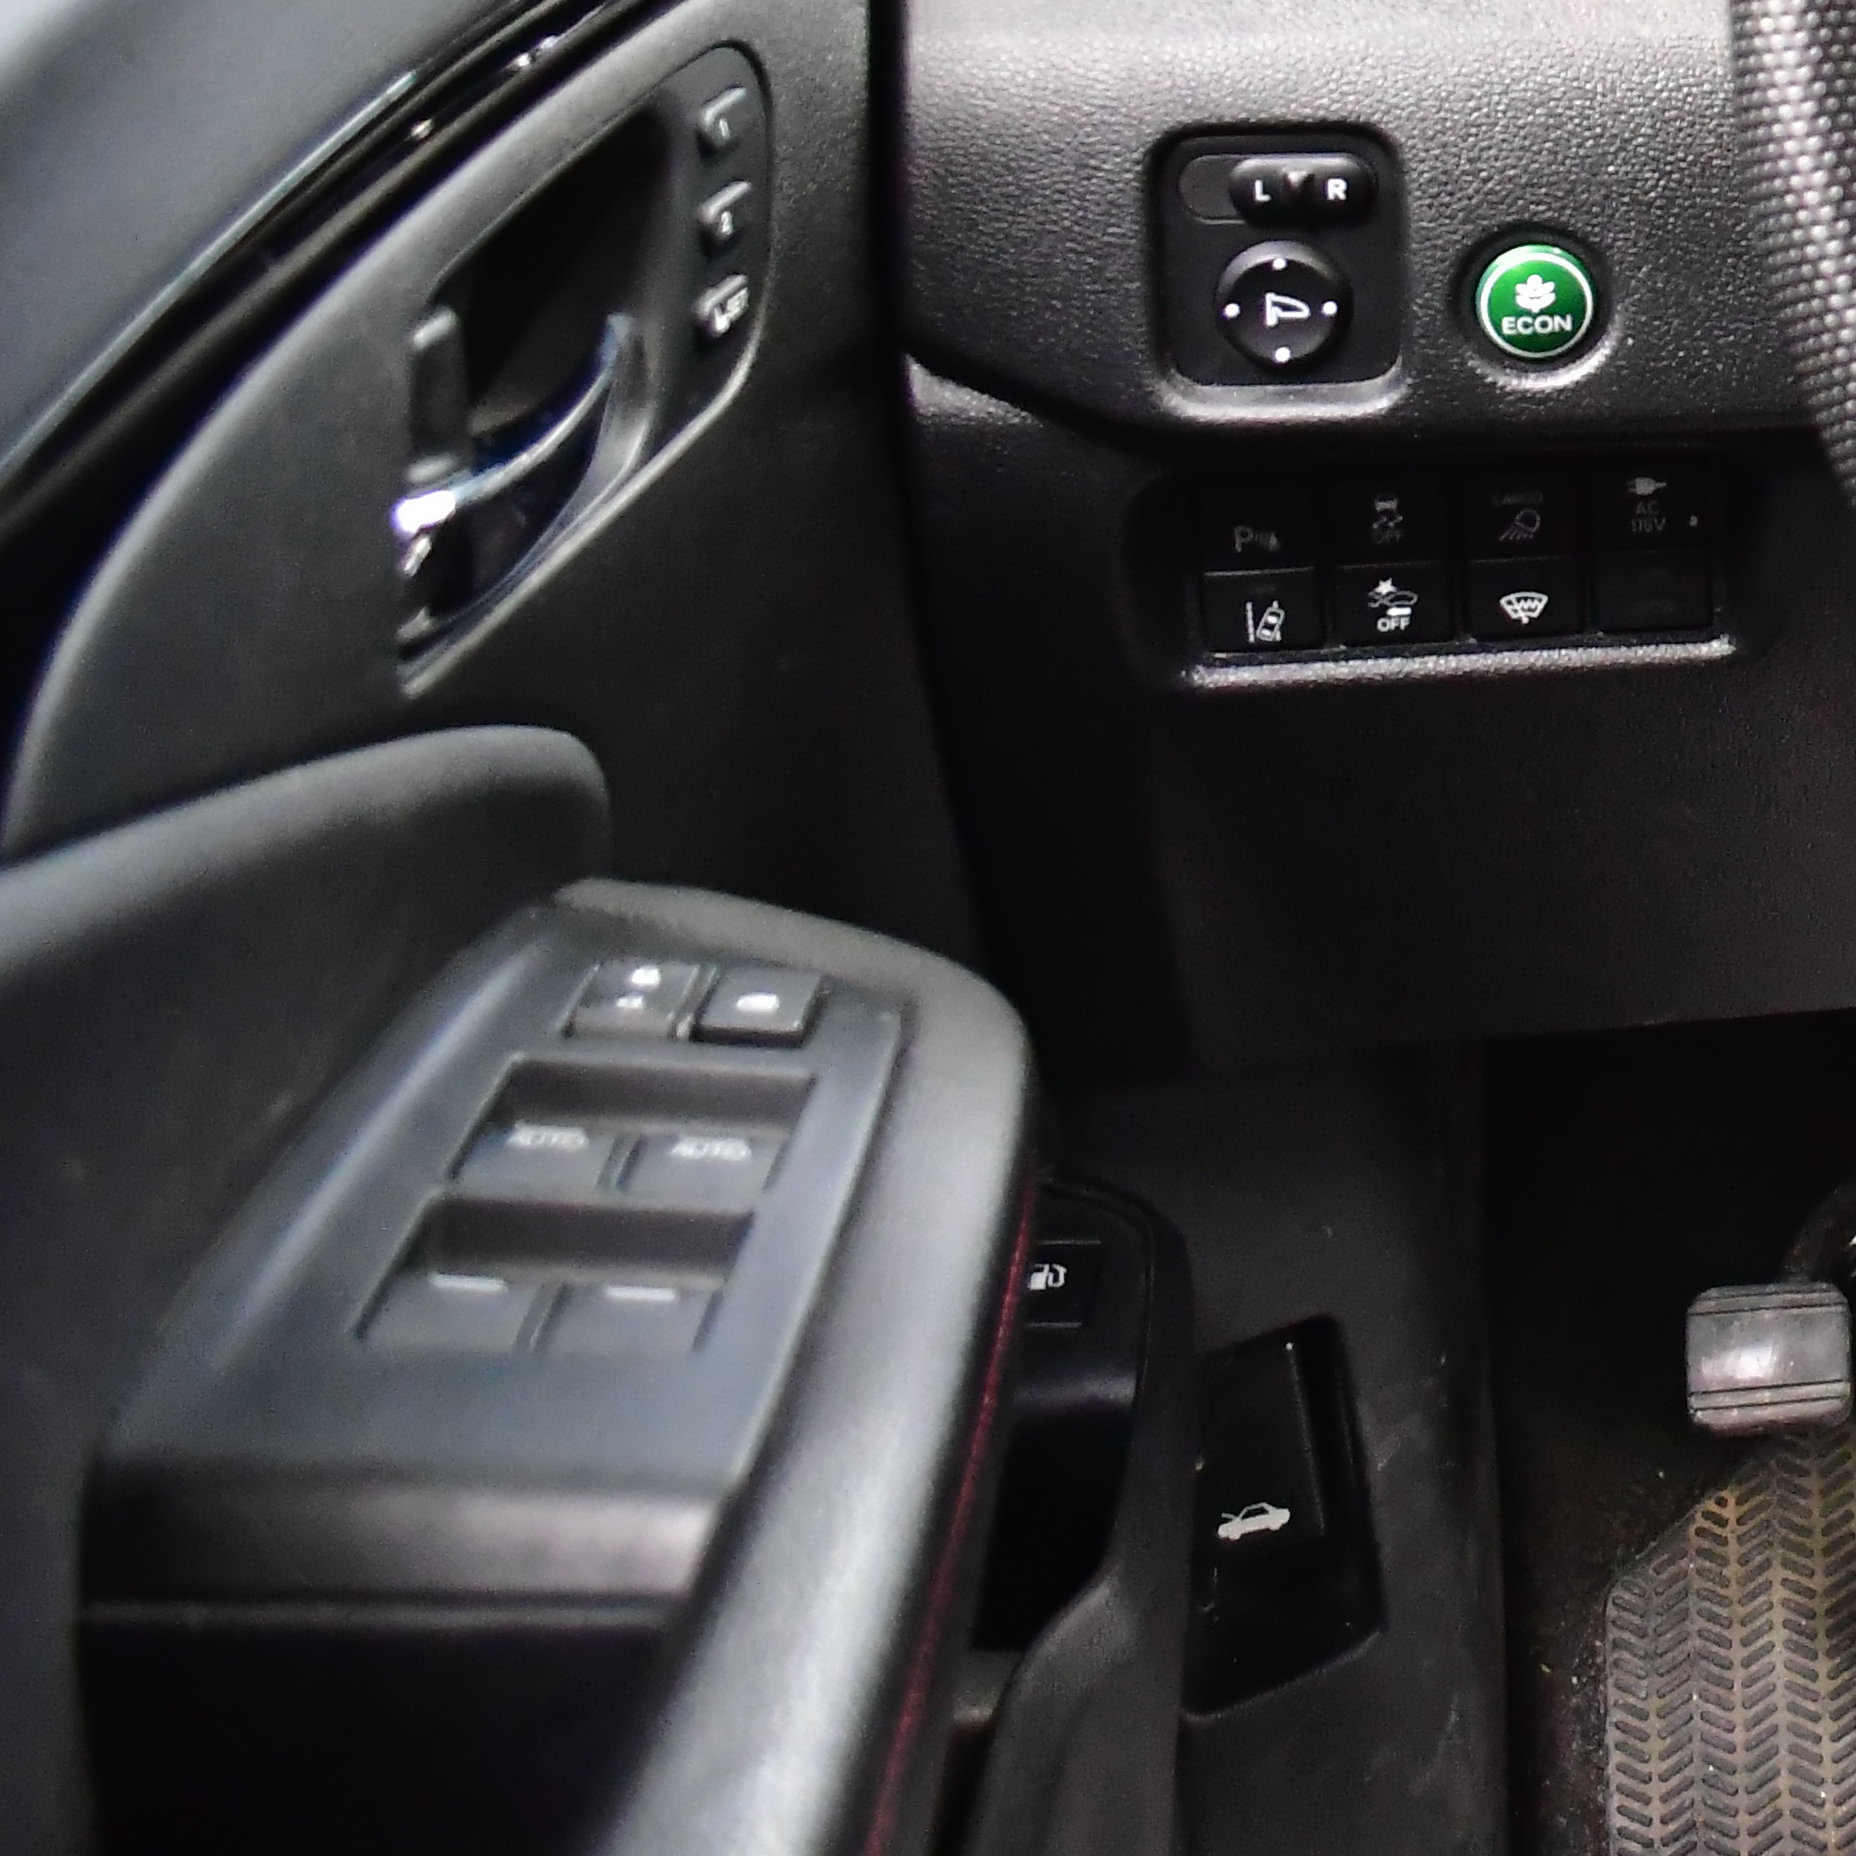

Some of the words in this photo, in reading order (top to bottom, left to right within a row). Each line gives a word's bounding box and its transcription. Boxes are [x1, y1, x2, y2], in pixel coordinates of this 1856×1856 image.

[1255, 180, 1272, 202] L
[1327, 178, 1348, 200] R
[1501, 313, 1574, 336] ECON
[1376, 615, 1411, 633] OFF
